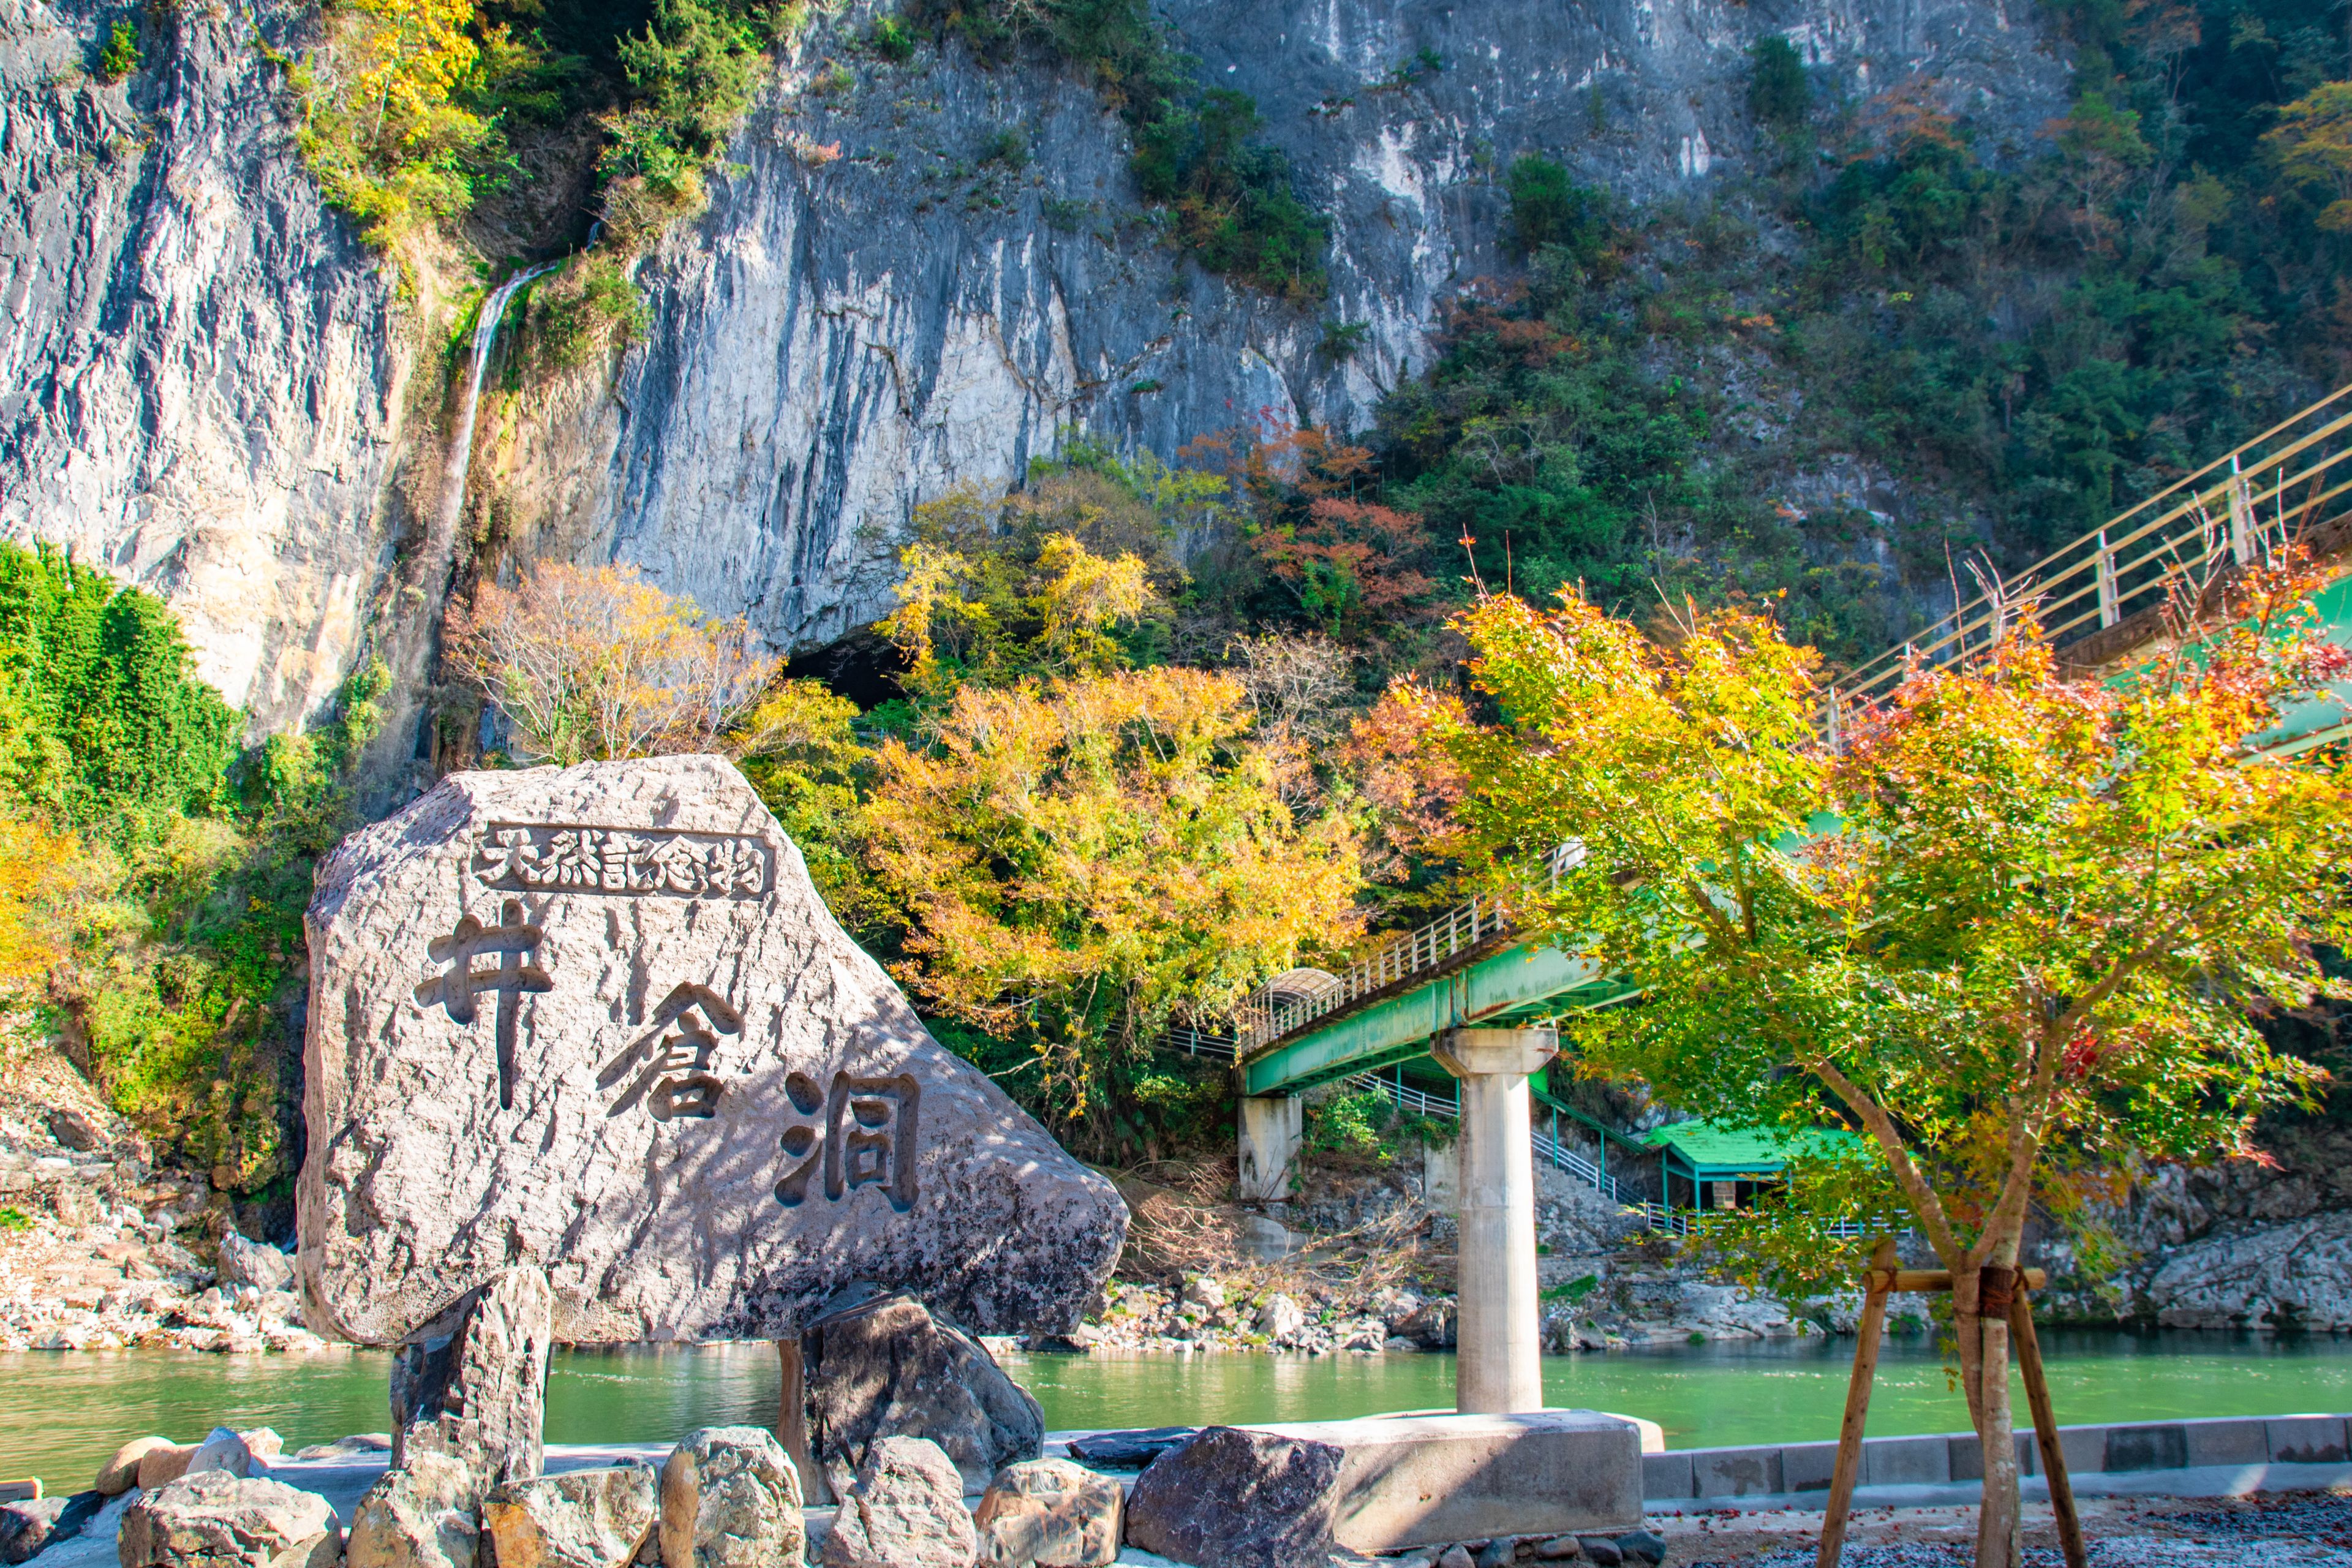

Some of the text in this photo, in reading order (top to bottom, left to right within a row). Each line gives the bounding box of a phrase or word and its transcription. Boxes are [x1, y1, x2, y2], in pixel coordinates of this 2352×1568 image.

[475, 829, 766, 894] 天然記念物
[413, 899, 921, 1213] 井倉洞
